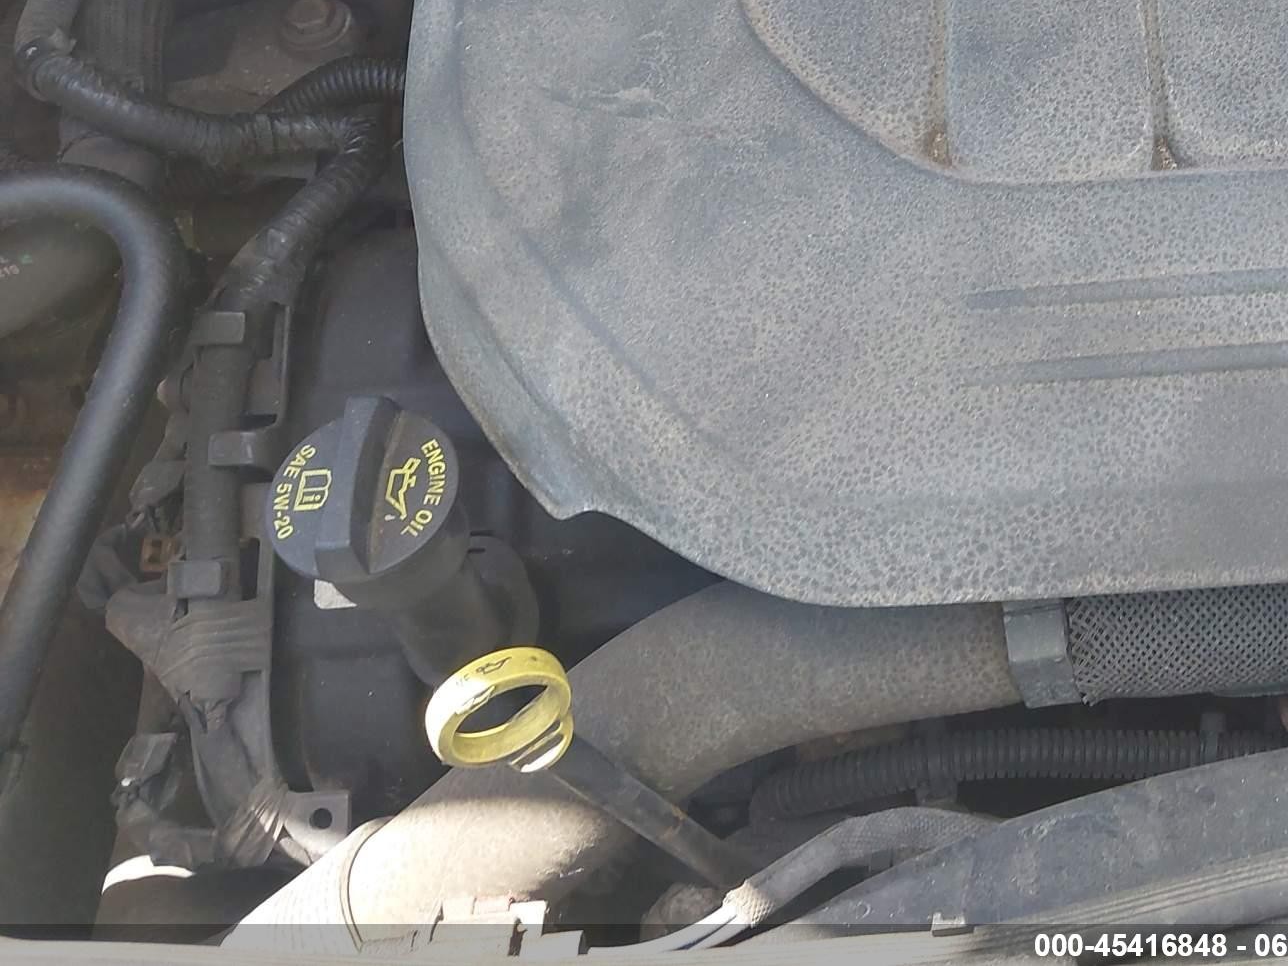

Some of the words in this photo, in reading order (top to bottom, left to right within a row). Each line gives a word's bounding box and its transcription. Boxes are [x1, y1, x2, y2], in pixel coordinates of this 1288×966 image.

[283, 444, 317, 479] SAE
[420, 438, 446, 506] ENGINE
[272, 483, 294, 540] 5W-20
[400, 508, 433, 538] OIL
